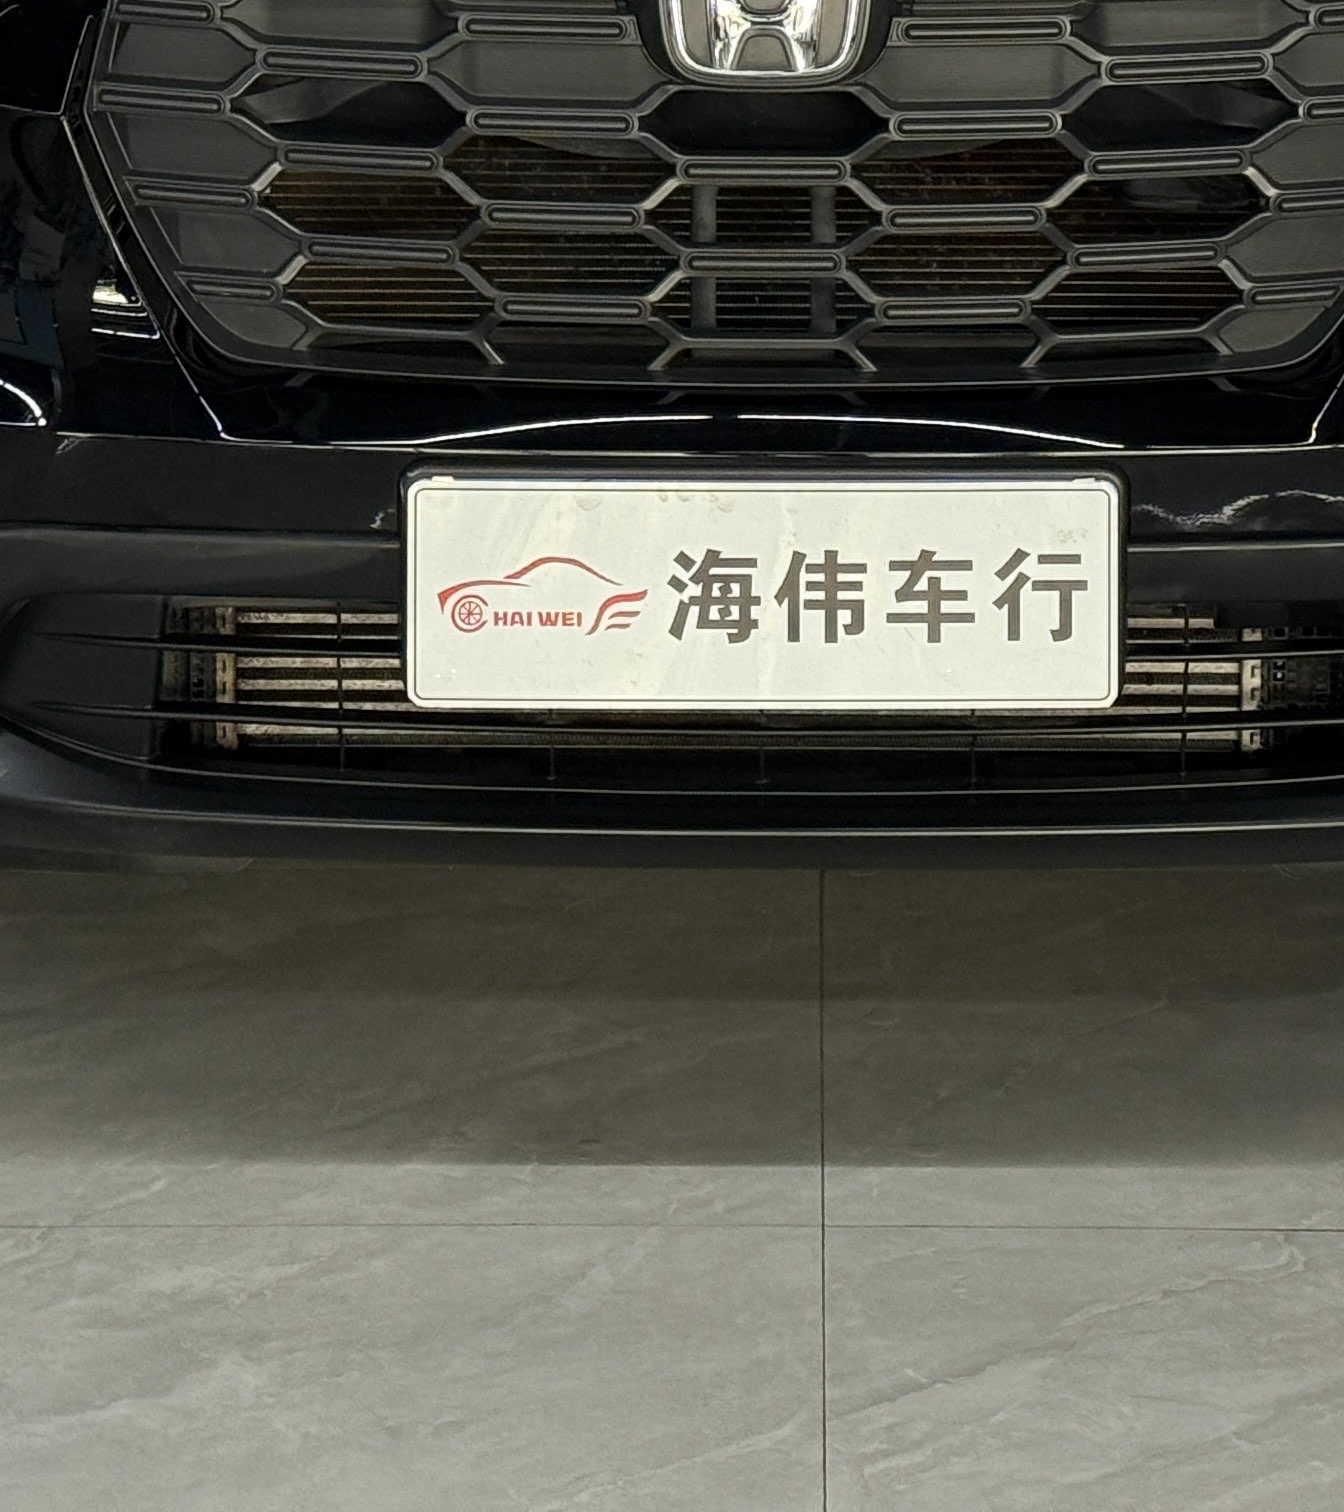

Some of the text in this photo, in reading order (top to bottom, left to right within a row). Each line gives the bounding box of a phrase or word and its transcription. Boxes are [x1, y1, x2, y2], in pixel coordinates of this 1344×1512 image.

[493, 611, 583, 627] HAI WEI
[667, 547, 1088, 644] 海伟车行
